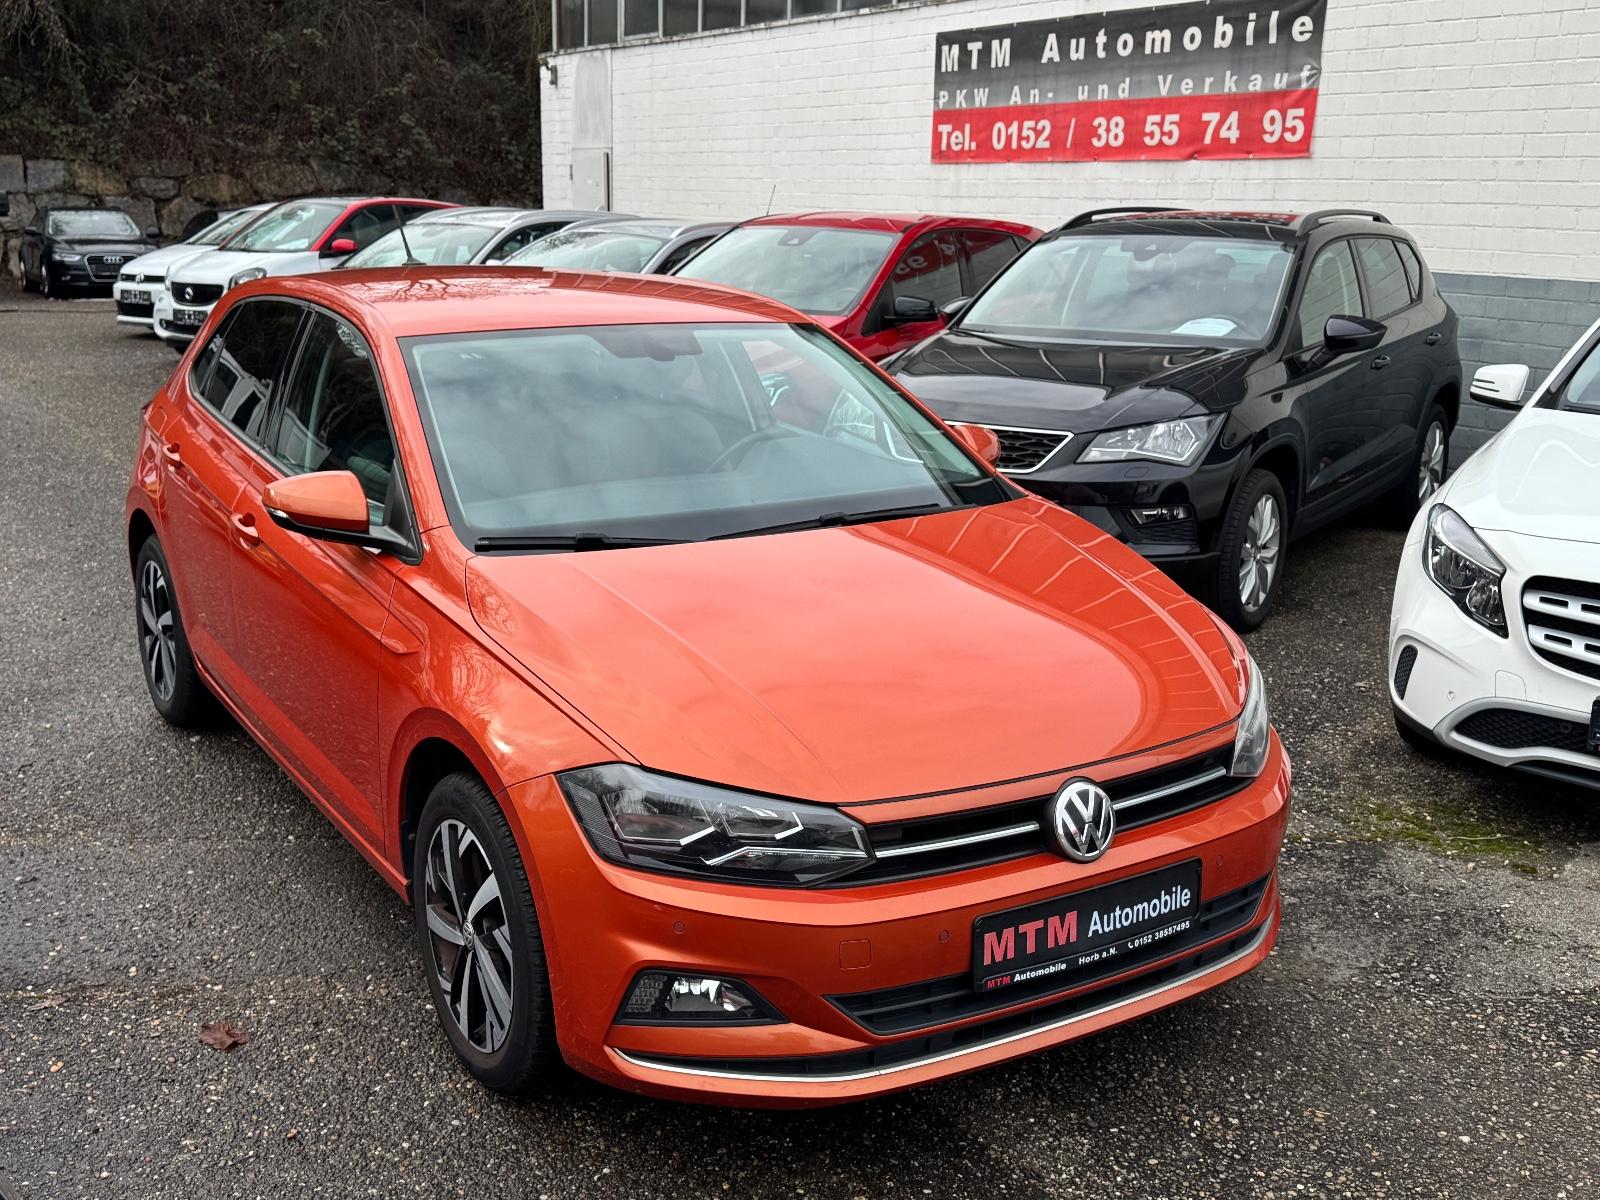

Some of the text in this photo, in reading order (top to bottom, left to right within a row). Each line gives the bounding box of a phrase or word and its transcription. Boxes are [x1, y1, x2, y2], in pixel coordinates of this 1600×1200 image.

[941, 11, 1314, 73] MTM Automobile
[938, 65, 1312, 109] PKW An- und Verkauf
[938, 108, 1305, 151] Tel. 0152 / 38 55 74 95
[983, 885, 1191, 966] MTM Automobile
[987, 920, 1190, 989] MTM Automobile Horb a.N. 0152 38557495
